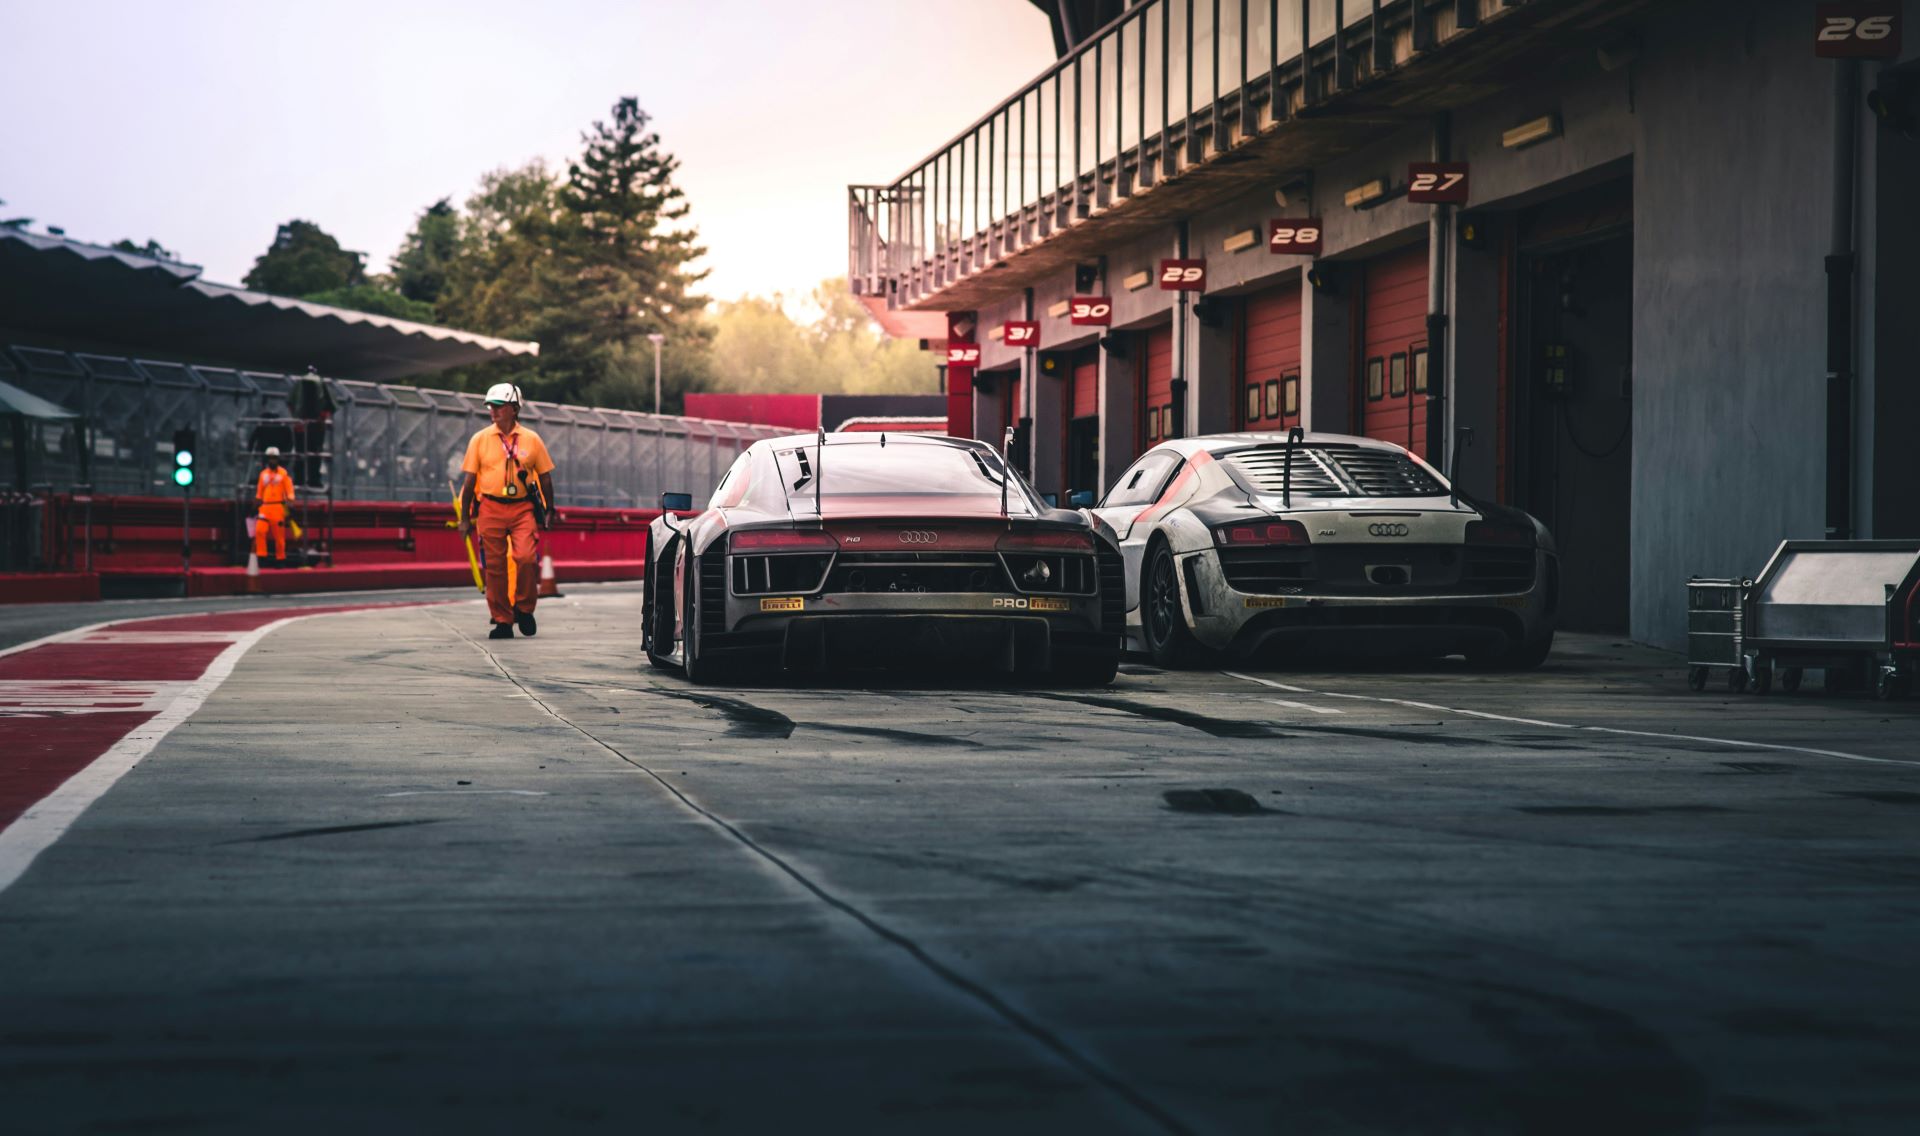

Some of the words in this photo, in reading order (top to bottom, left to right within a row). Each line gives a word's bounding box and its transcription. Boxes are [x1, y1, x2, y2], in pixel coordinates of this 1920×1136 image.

[1817, 16, 1895, 41] 26
[1410, 173, 1465, 191] 27
[1271, 227, 1319, 244] 28
[1162, 267, 1203, 282] 29
[1072, 304, 1110, 318] 30
[1008, 327, 1034, 340] 31
[948, 349, 979, 361] 32
[761, 598, 802, 610] PIRELLI
[992, 598, 1027, 608] PRO
